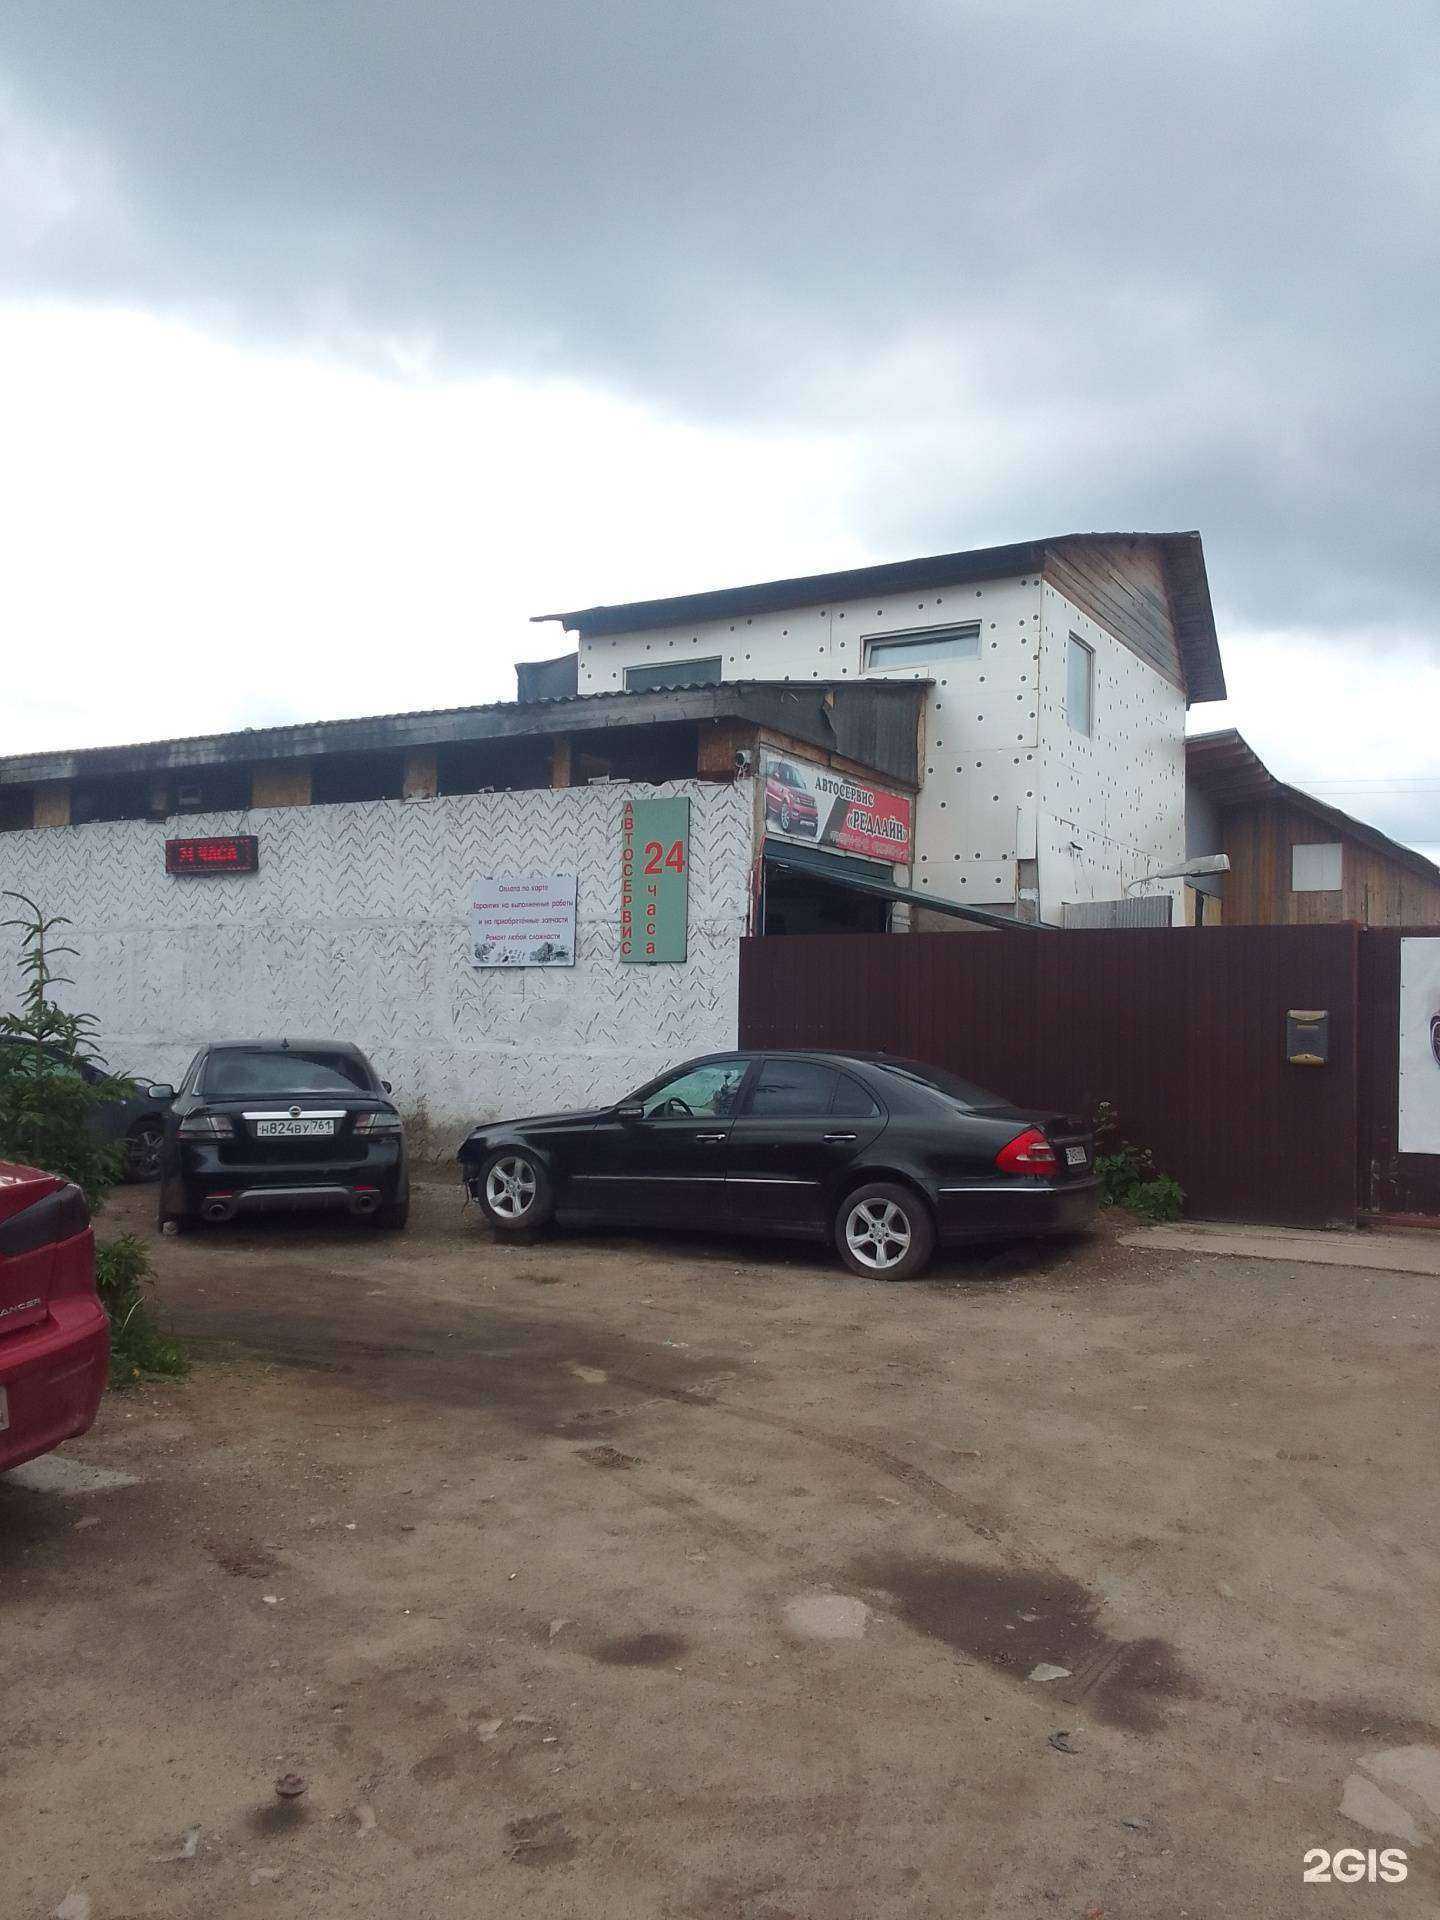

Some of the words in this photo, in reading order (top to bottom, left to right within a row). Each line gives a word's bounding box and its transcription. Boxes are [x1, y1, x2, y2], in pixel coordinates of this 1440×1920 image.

[815, 777, 874, 806] АВТОСЕРВИС
[644, 840, 685, 875] 24
[499, 884, 520, 892] Оплата
[621, 801, 634, 954] АВТОСЕРВИС
[473, 902, 500, 910] Гарантия
[552, 898, 574, 909] работы
[0, 1297, 41, 1317] ANCER
